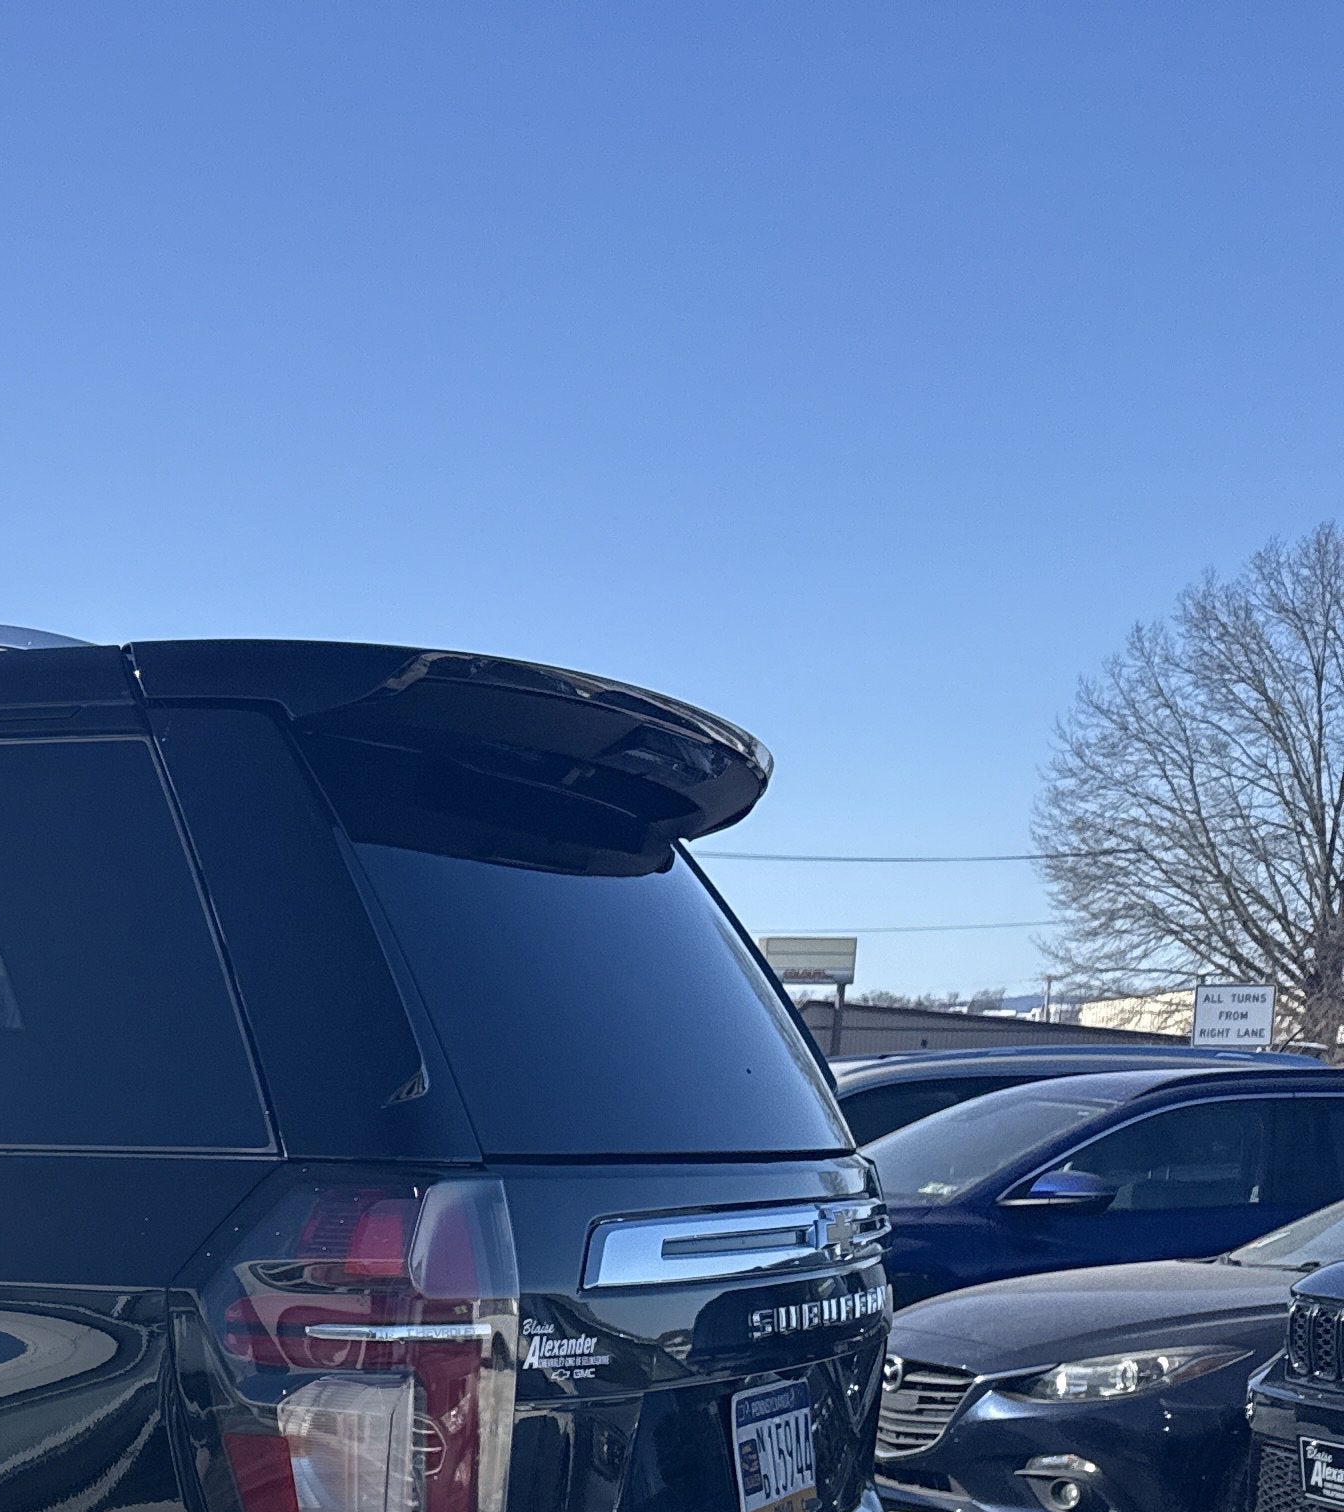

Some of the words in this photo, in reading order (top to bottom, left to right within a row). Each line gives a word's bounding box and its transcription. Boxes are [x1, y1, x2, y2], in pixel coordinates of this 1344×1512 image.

[1202, 993, 1224, 1003] ALL
[1231, 993, 1268, 1004] TURNS
[1218, 1010, 1249, 1021] FROM
[1199, 1027, 1231, 1039] RIGHT
[1237, 1027, 1266, 1039] LANE
[748, 1286, 886, 1339] SUBURBAN
[522, 1318, 555, 1335] Blaise
[522, 1333, 598, 1370] Alexander
[573, 1368, 596, 1379] GMC
